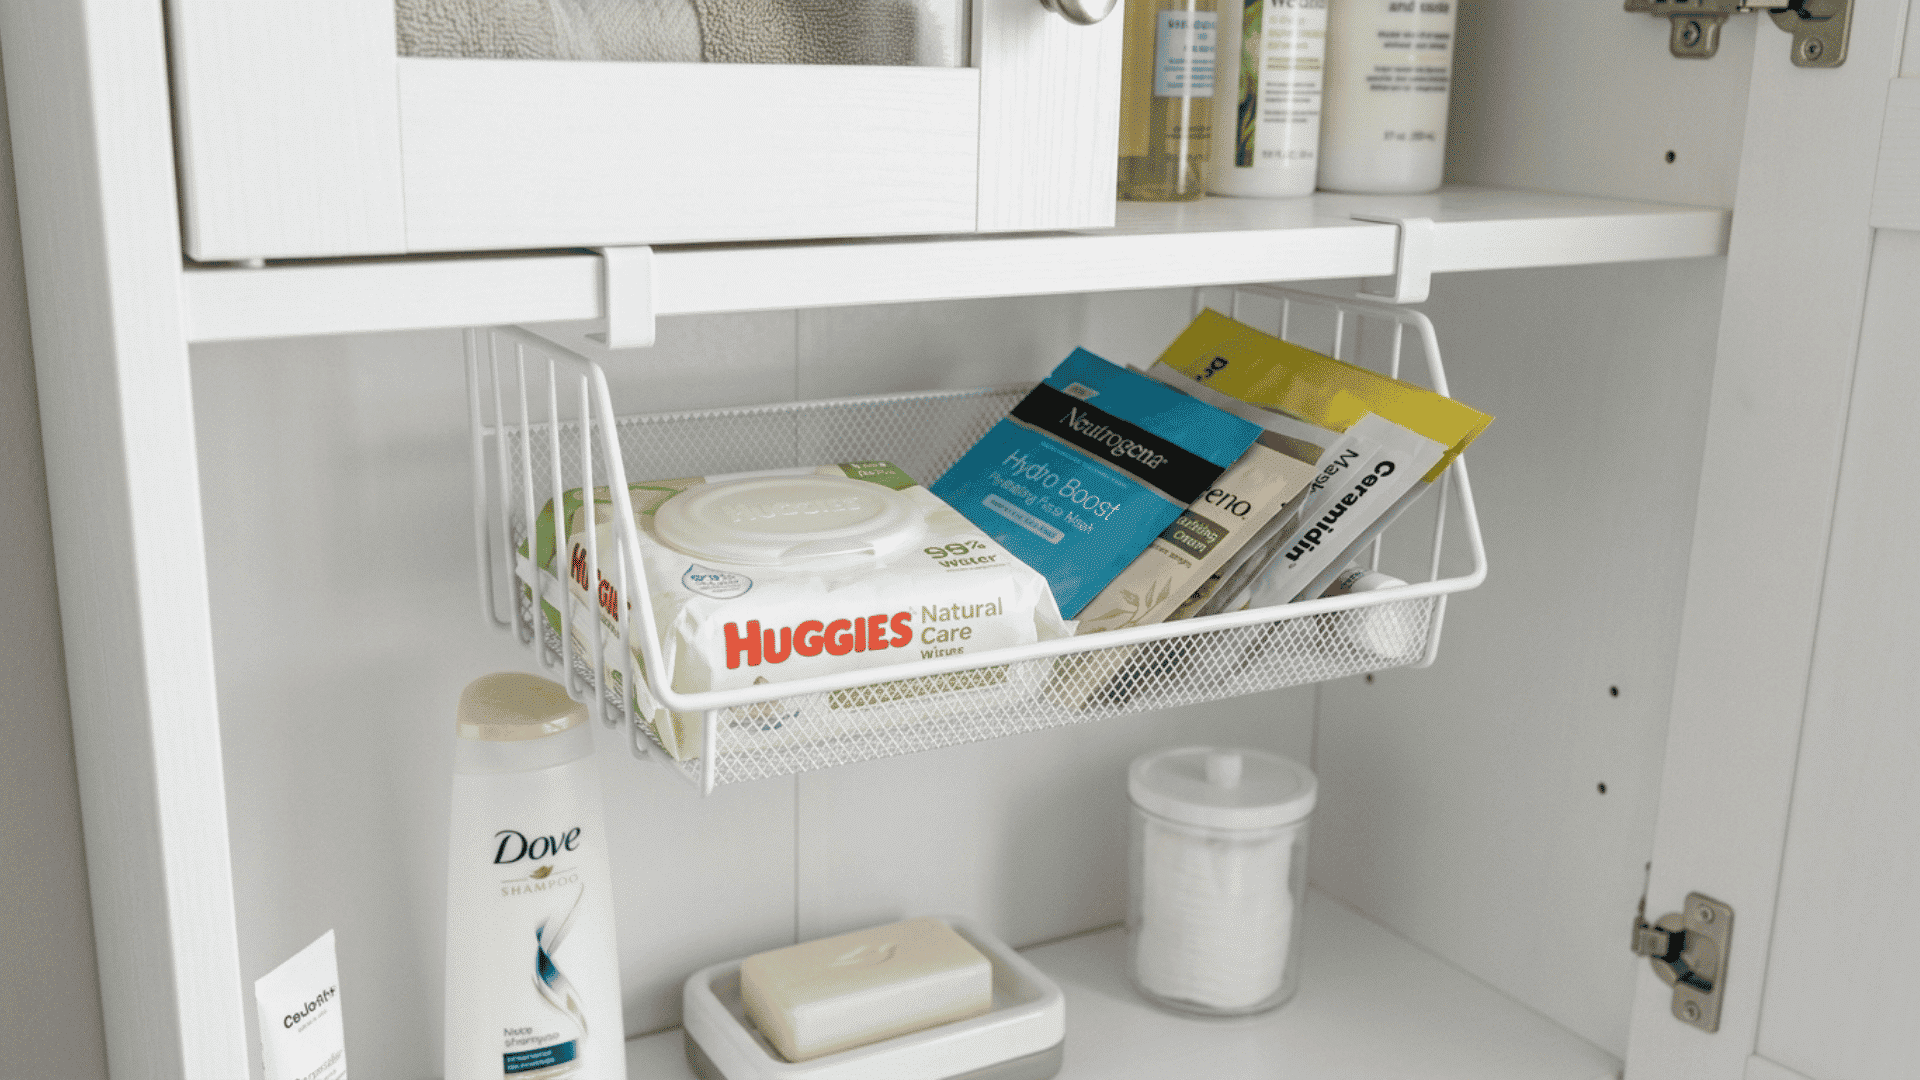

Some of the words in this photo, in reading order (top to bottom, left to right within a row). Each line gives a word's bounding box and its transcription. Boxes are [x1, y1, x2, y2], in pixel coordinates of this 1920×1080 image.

[1059, 407, 1165, 469] Neutrogena
[1002, 449, 1059, 488] Hydro
[1059, 478, 1121, 521] Boost
[1285, 461, 1395, 561] Ceramidin
[922, 597, 1003, 624] Natural
[724, 611, 913, 669] HUGGIES
[921, 626, 972, 645] Care
[493, 827, 581, 864] Dove
[501, 874, 580, 897] SHAMPOO
